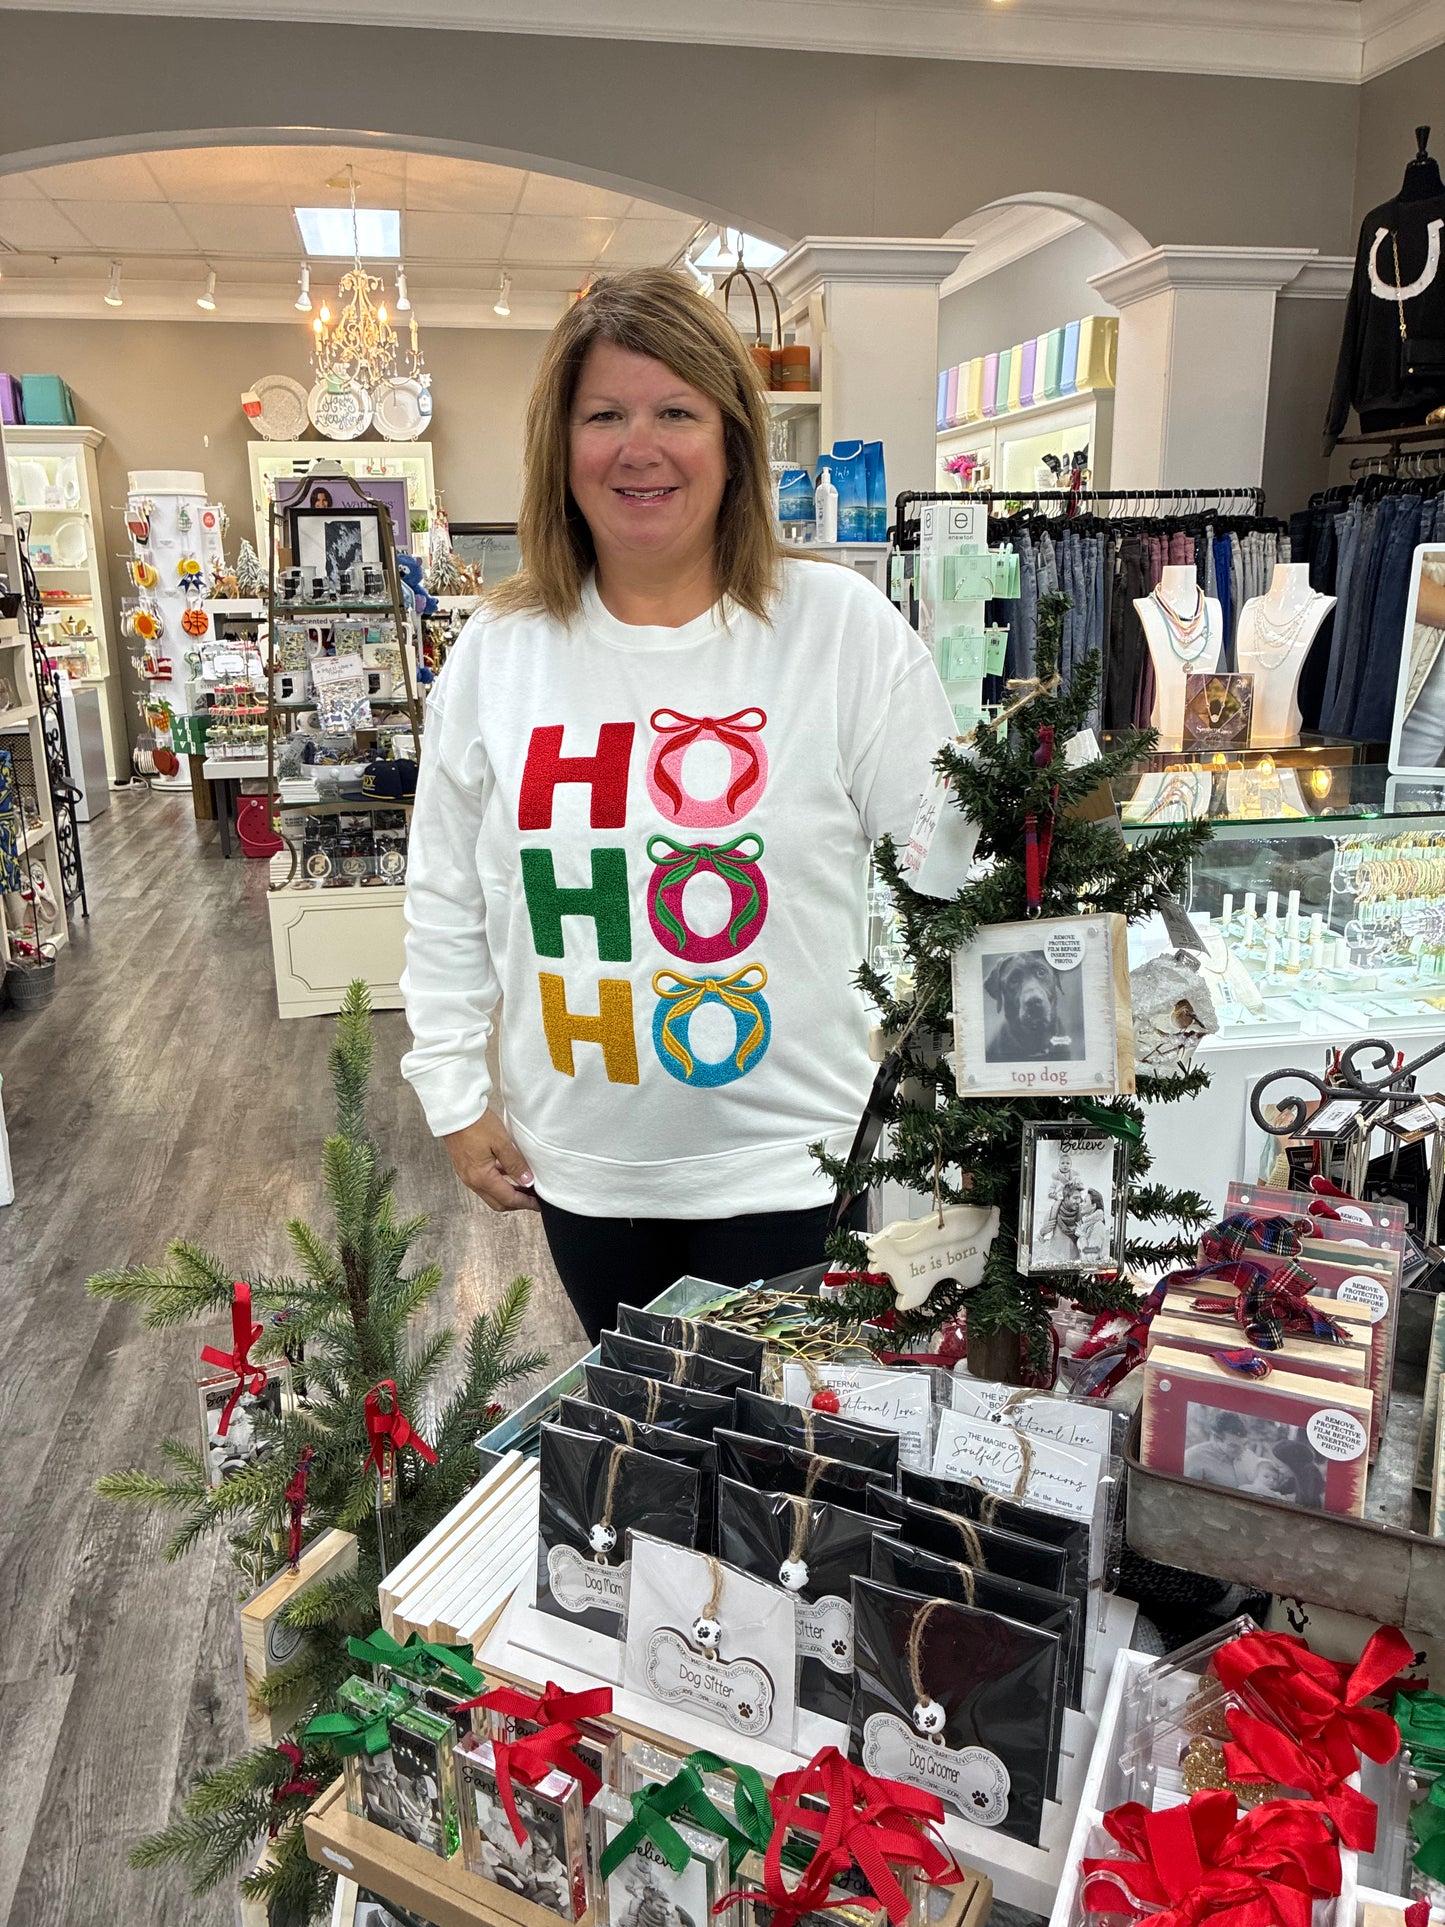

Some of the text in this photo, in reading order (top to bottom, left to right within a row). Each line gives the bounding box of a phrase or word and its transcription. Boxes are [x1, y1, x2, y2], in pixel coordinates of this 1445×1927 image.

[518, 714, 768, 830] HO
[520, 843, 768, 963] HO
[539, 973, 771, 1088] HO
[1011, 1066, 1068, 1086] top dog
[1060, 1131, 1105, 1153] Believe
[1339, 1212, 1364, 1223] REMOVE
[910, 1246, 978, 1278] he is born
[1344, 1287, 1384, 1301] PROTECTIVE
[1352, 1282, 1379, 1293] REMOVE
[1342, 1293, 1384, 1308] FILM BEFORE
[827, 1380, 862, 1389] ETERNAL
[980, 1392, 998, 1401] THE
[893, 1398, 916, 1420] Love
[1316, 1420, 1361, 1439] PROTECTIVE
[1325, 1416, 1355, 1430] REMOVE
[968, 1431, 984, 1442] THE
[984, 1435, 1007, 1449] MAGIC
[1069, 1425, 1094, 1446] Love
[1313, 1426, 1361, 1446] FILM BEFORE
[1316, 1434, 1355, 1451] INSERTING
[951, 1435, 1001, 1466] Soulful
[1321, 1442, 1347, 1455] PHOTO.
[946, 1464, 957, 1472] Cats
[960, 1469, 973, 1477] hold
[1002, 1452, 1087, 1492] Copanions
[1055, 1497, 1073, 1508] hearts
[585, 1573, 623, 1596] Dog Mom
[795, 1619, 825, 1639] Sitter
[680, 1663, 734, 1698] Dog Sitter
[909, 1748, 960, 1783] Dog Groomer
[536, 1807, 560, 1823] me
